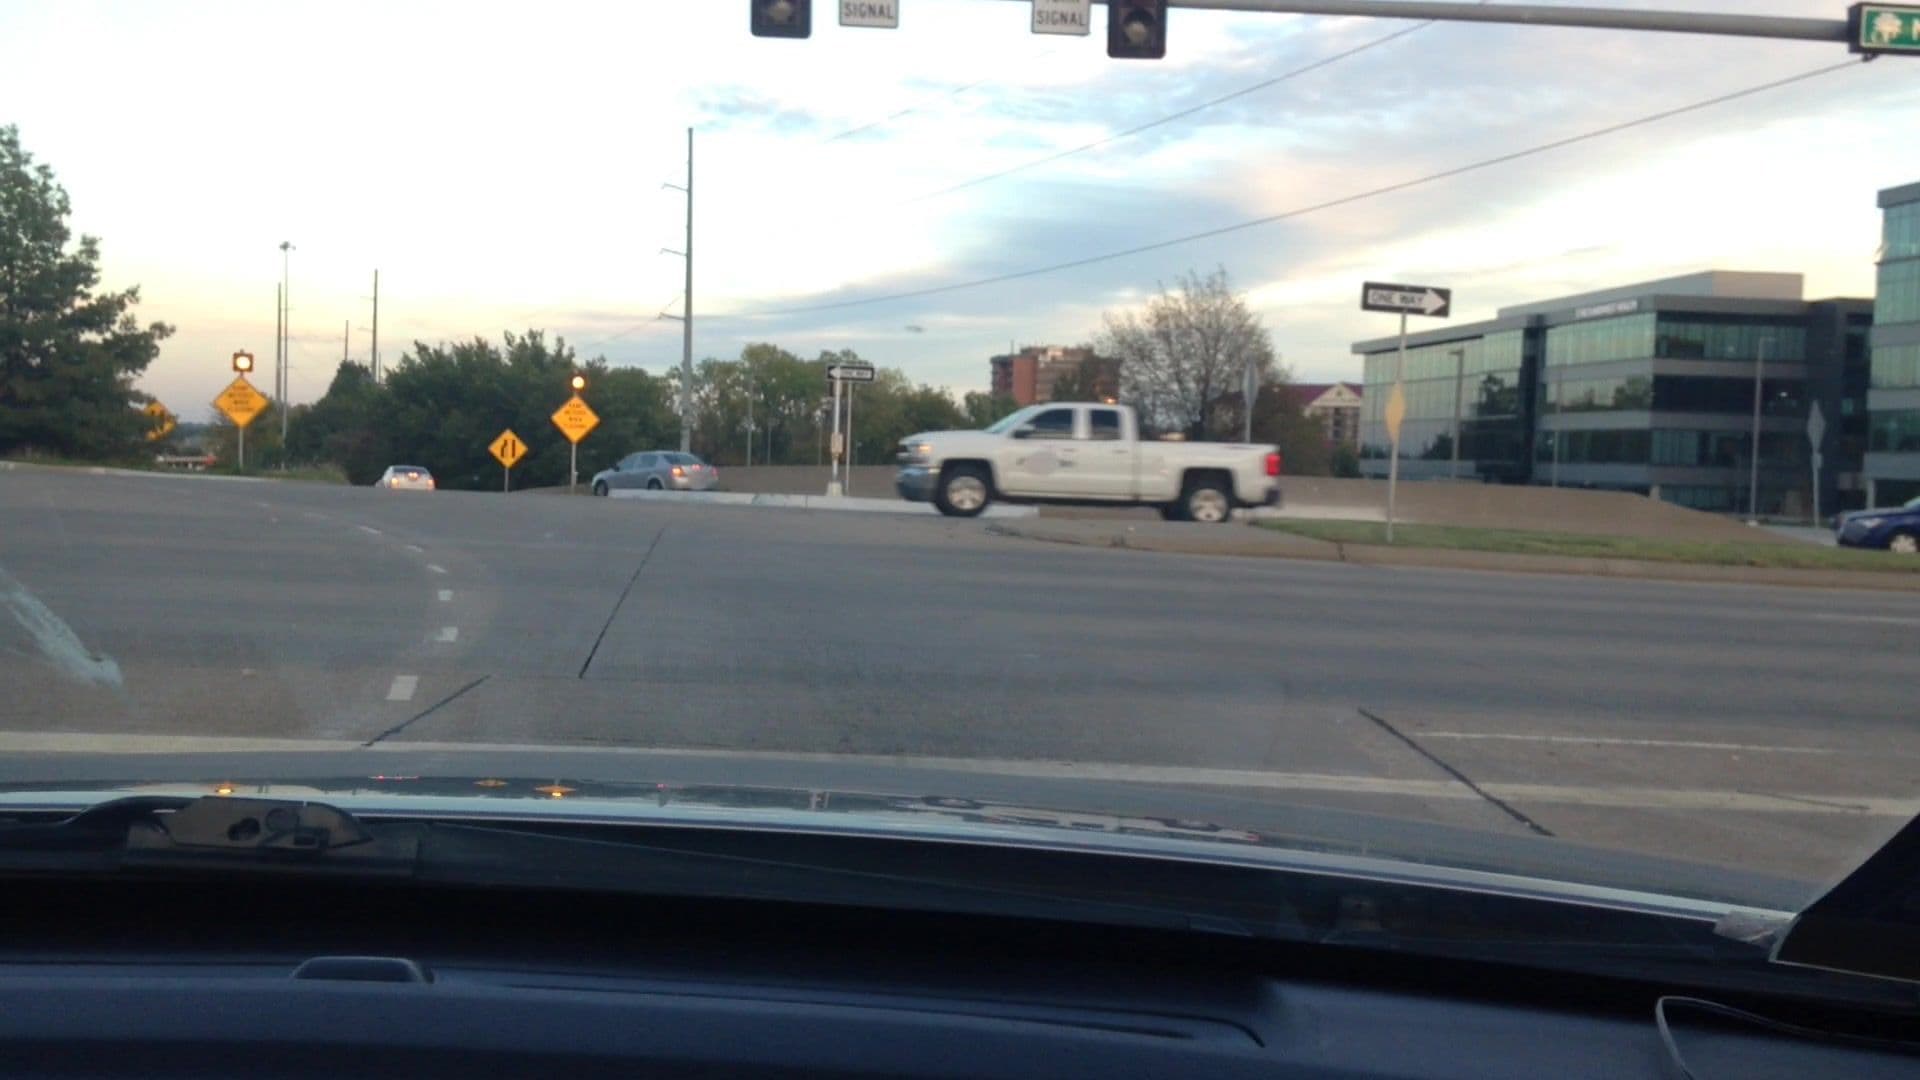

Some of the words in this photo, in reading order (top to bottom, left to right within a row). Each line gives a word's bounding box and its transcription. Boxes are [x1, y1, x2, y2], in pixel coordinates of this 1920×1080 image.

[844, 3, 894, 20] SIGNAL
[1036, 9, 1085, 26] SIGNAL
[1370, 291, 1392, 304] ONE
[1399, 293, 1423, 305] WAY
